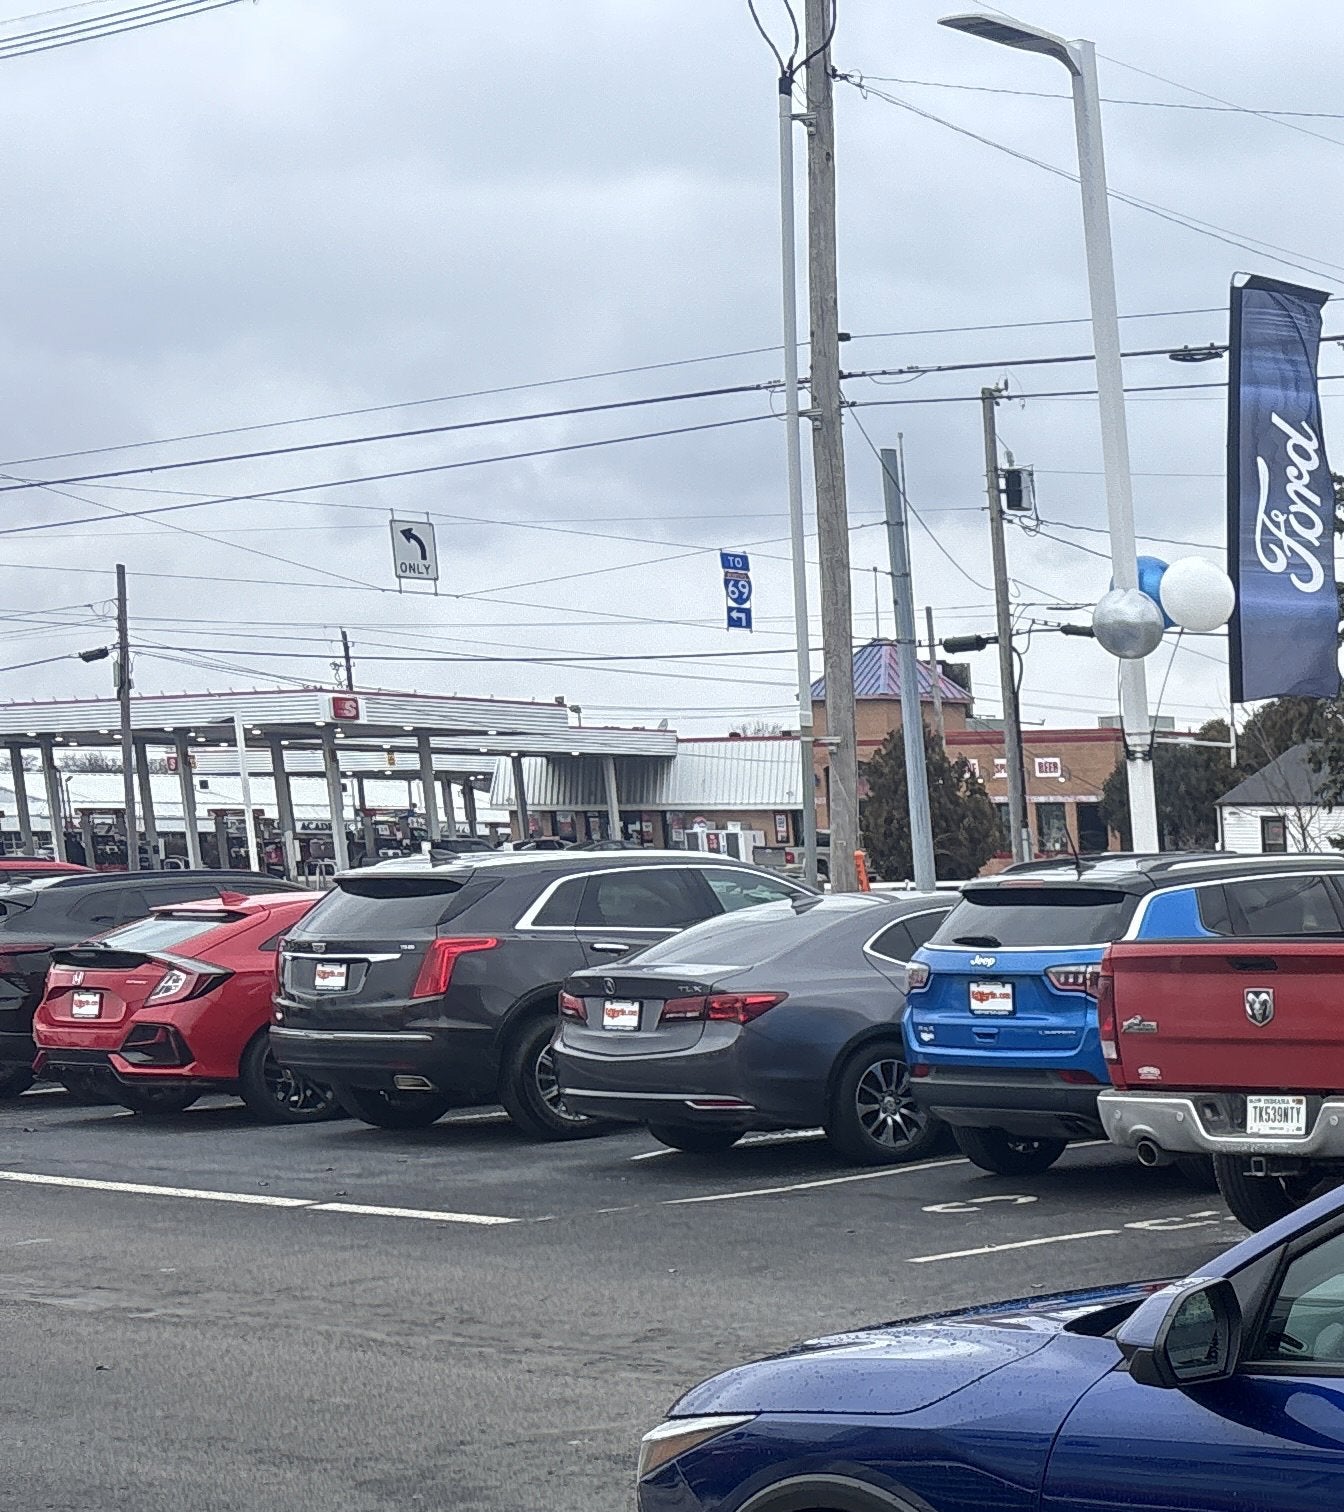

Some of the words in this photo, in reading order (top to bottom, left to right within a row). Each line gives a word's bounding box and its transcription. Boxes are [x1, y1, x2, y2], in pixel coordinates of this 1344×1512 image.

[1255, 411, 1325, 593] Ford
[400, 562, 431, 575] ONLY
[727, 556, 743, 568] TO
[728, 580, 749, 599] 69
[1038, 761, 1059, 774] BEER
[970, 955, 995, 967] Jeep
[678, 985, 702, 993] TLX
[1252, 1105, 1302, 1123] TK539NTY
